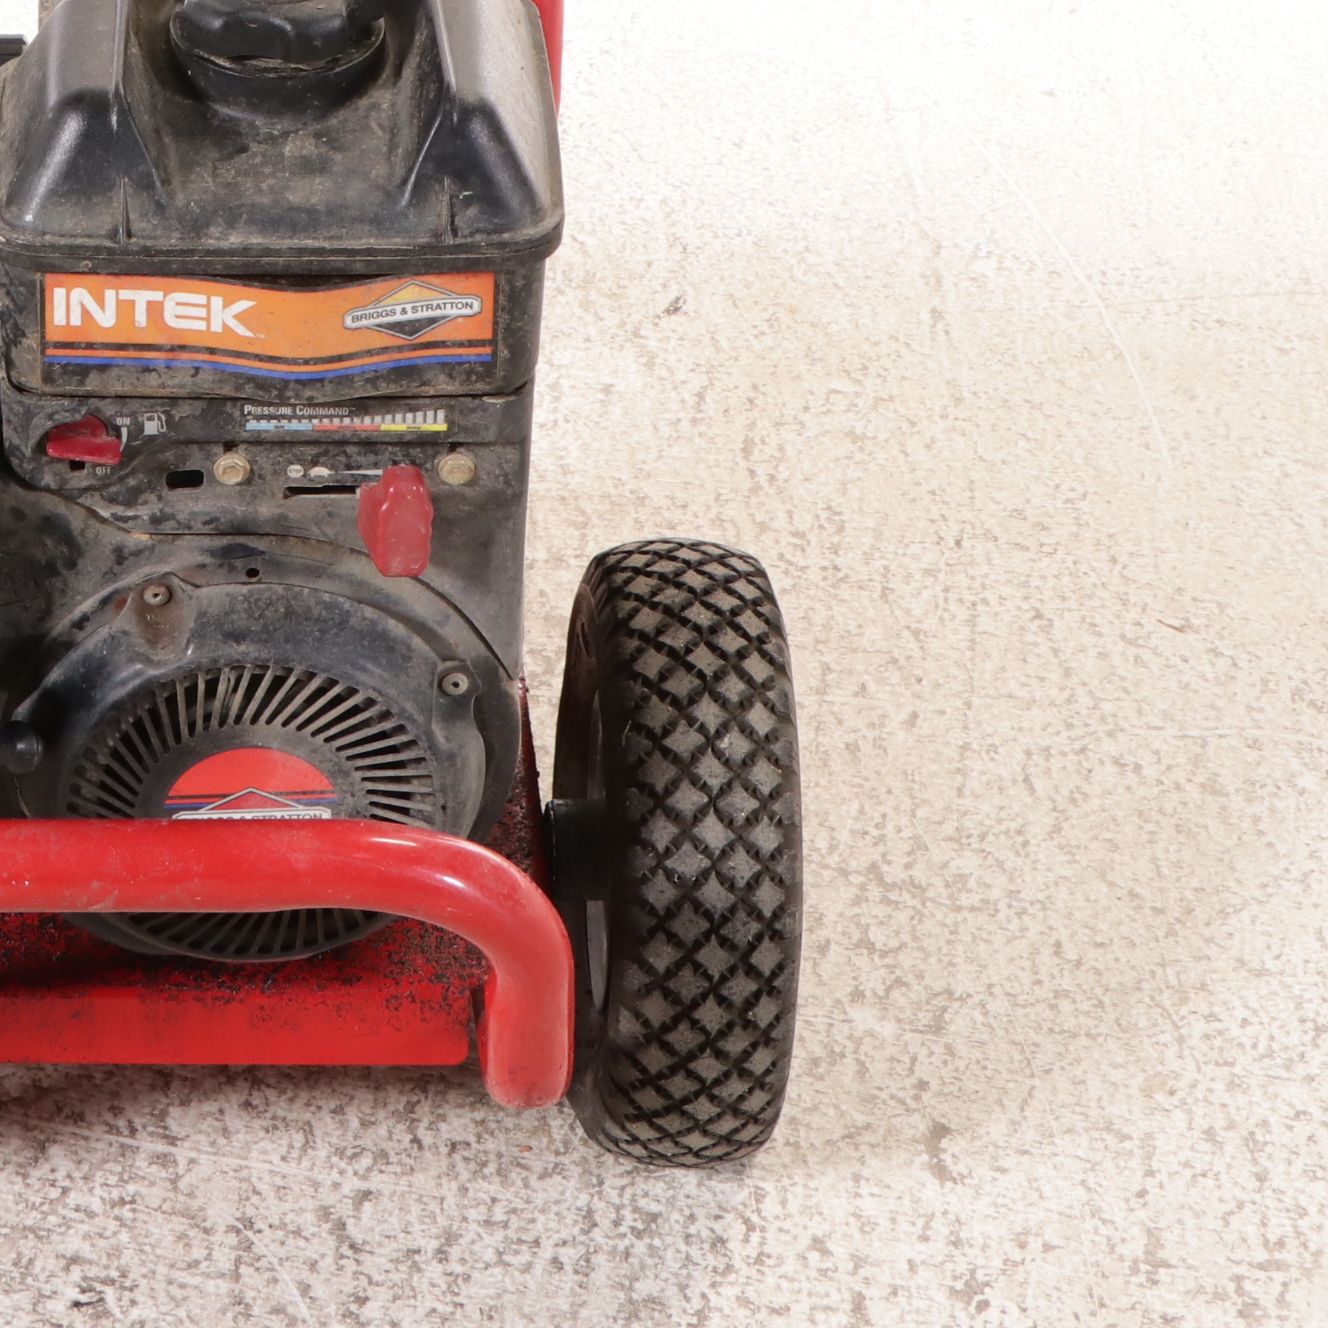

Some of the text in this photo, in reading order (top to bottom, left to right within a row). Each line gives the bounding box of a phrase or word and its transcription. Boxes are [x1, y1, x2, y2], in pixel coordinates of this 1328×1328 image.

[53, 287, 257, 338] INTEK
[351, 301, 473, 323] BRIGGS & STRATTON
[116, 416, 130, 426] ON
[95, 466, 112, 474] OFF
